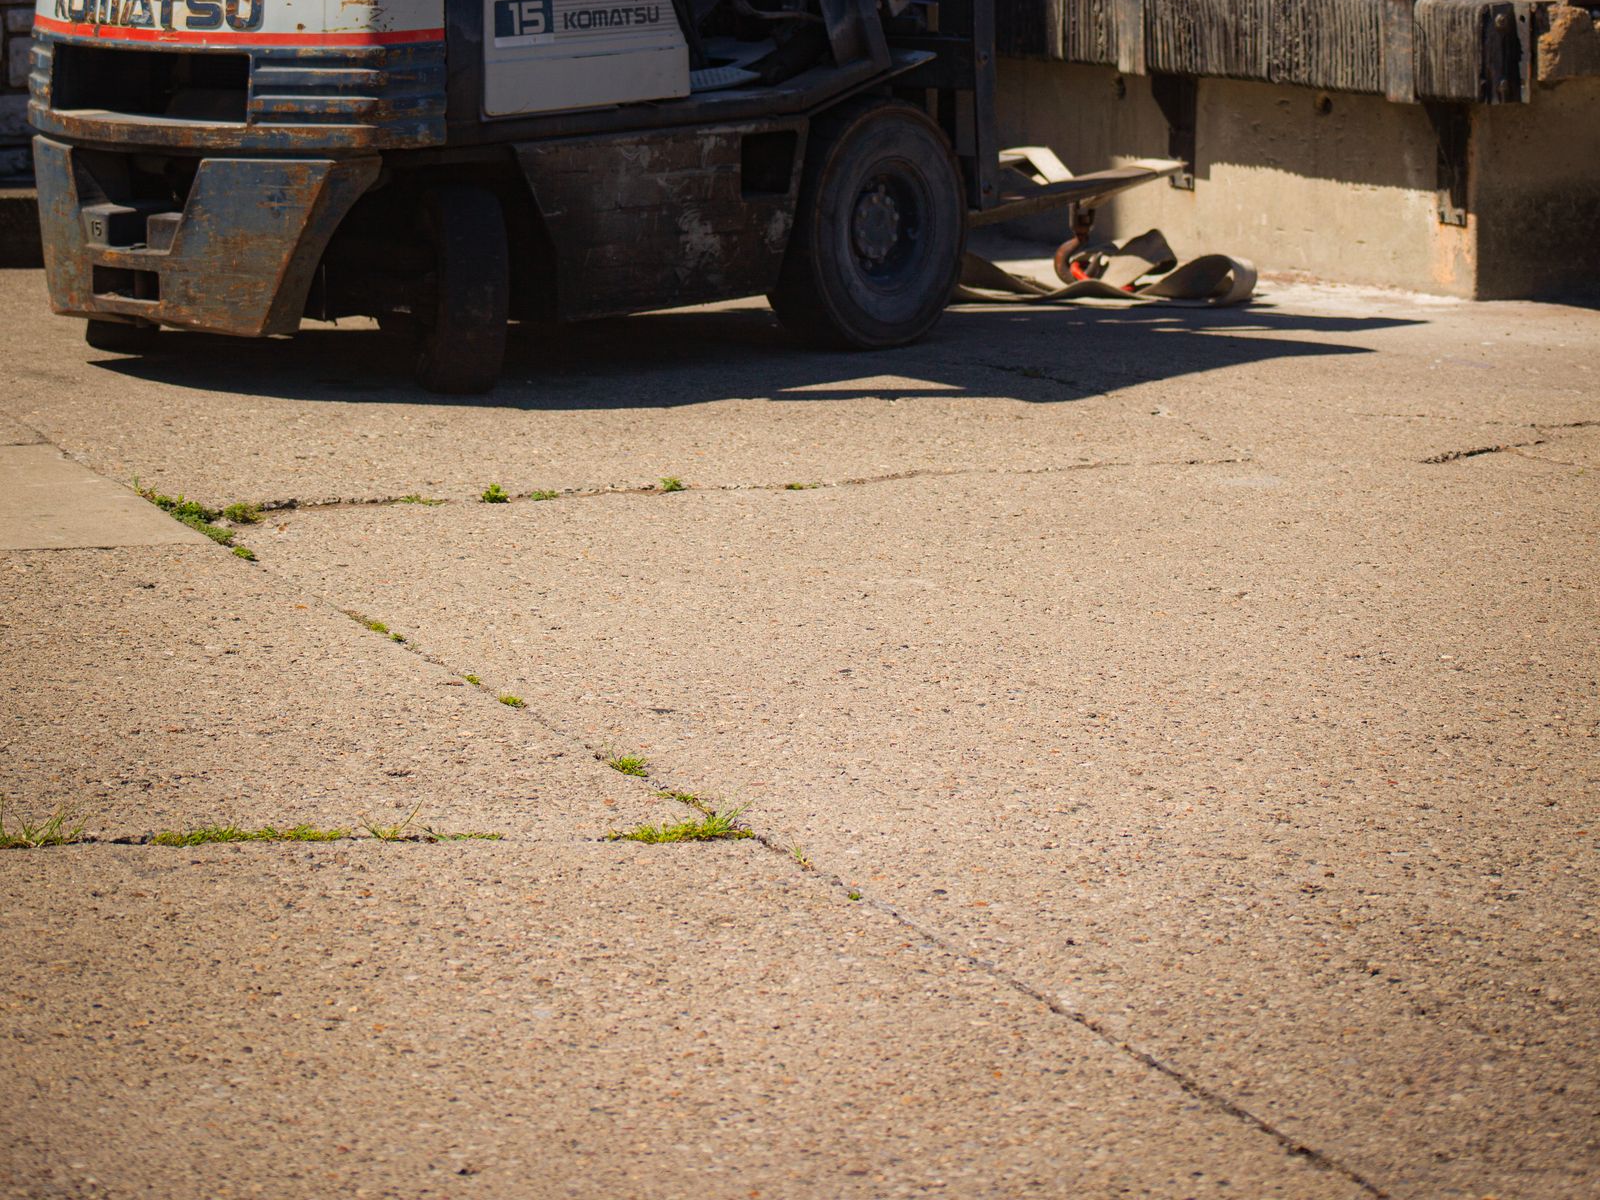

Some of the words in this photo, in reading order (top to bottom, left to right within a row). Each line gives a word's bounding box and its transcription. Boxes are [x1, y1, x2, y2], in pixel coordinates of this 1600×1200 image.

[508, 0, 546, 36] 15
[563, 6, 660, 30] KOMATSU
[91, 221, 103, 236] 15
